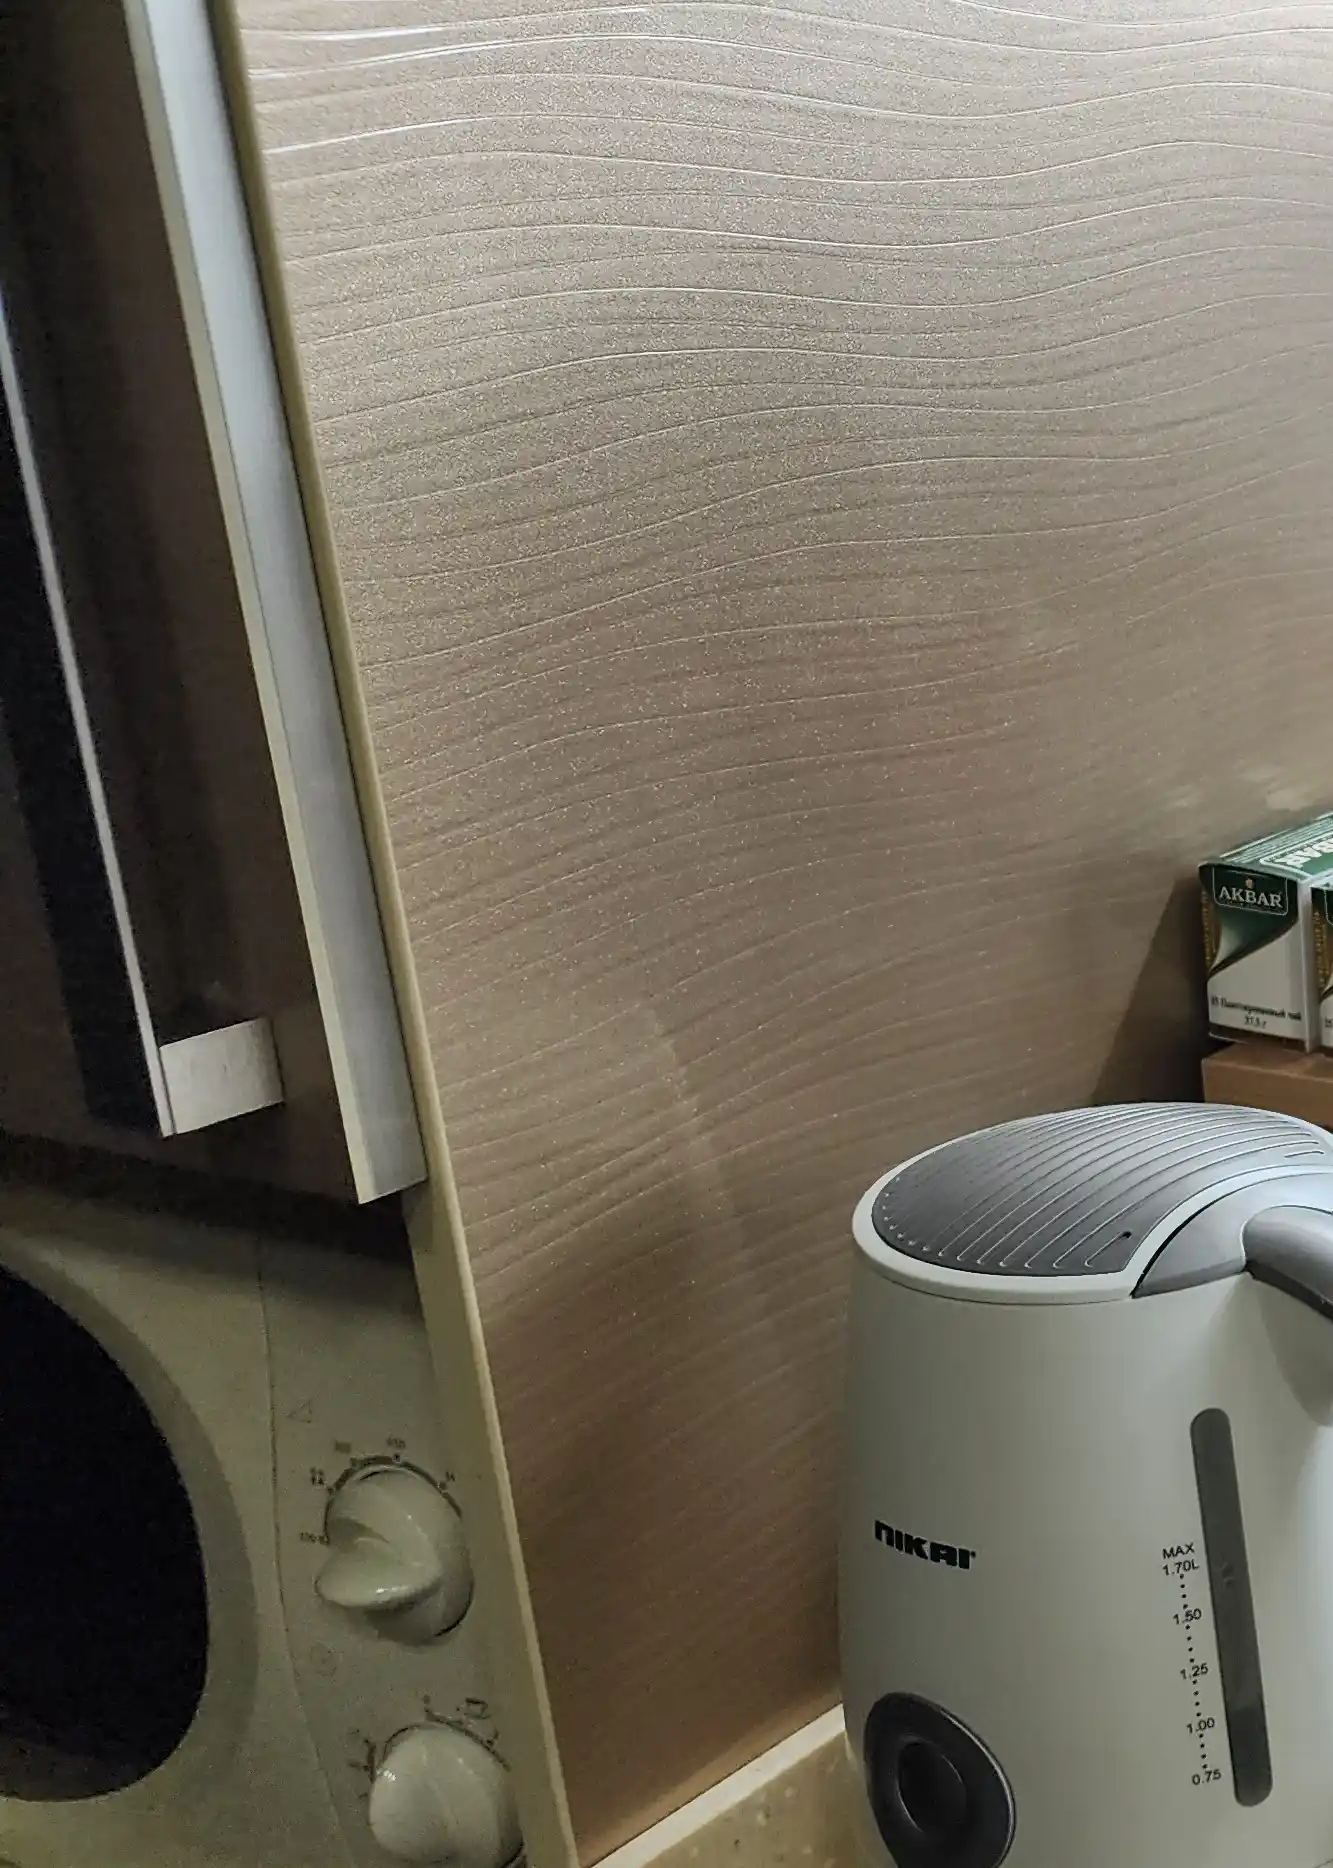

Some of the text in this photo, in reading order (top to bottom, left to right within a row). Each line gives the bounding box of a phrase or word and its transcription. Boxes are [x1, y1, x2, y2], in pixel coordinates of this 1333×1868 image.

[1218, 886, 1284, 909] AKBAR
[1162, 1542, 1195, 1559] MAX
[1162, 1558, 1200, 1577] 1.70L
[1173, 1608, 1202, 1625] 1.50
[1180, 1663, 1208, 1680] 1.25
[1187, 1717, 1215, 1734] 1.00
[1191, 1768, 1222, 1786] 0.75
